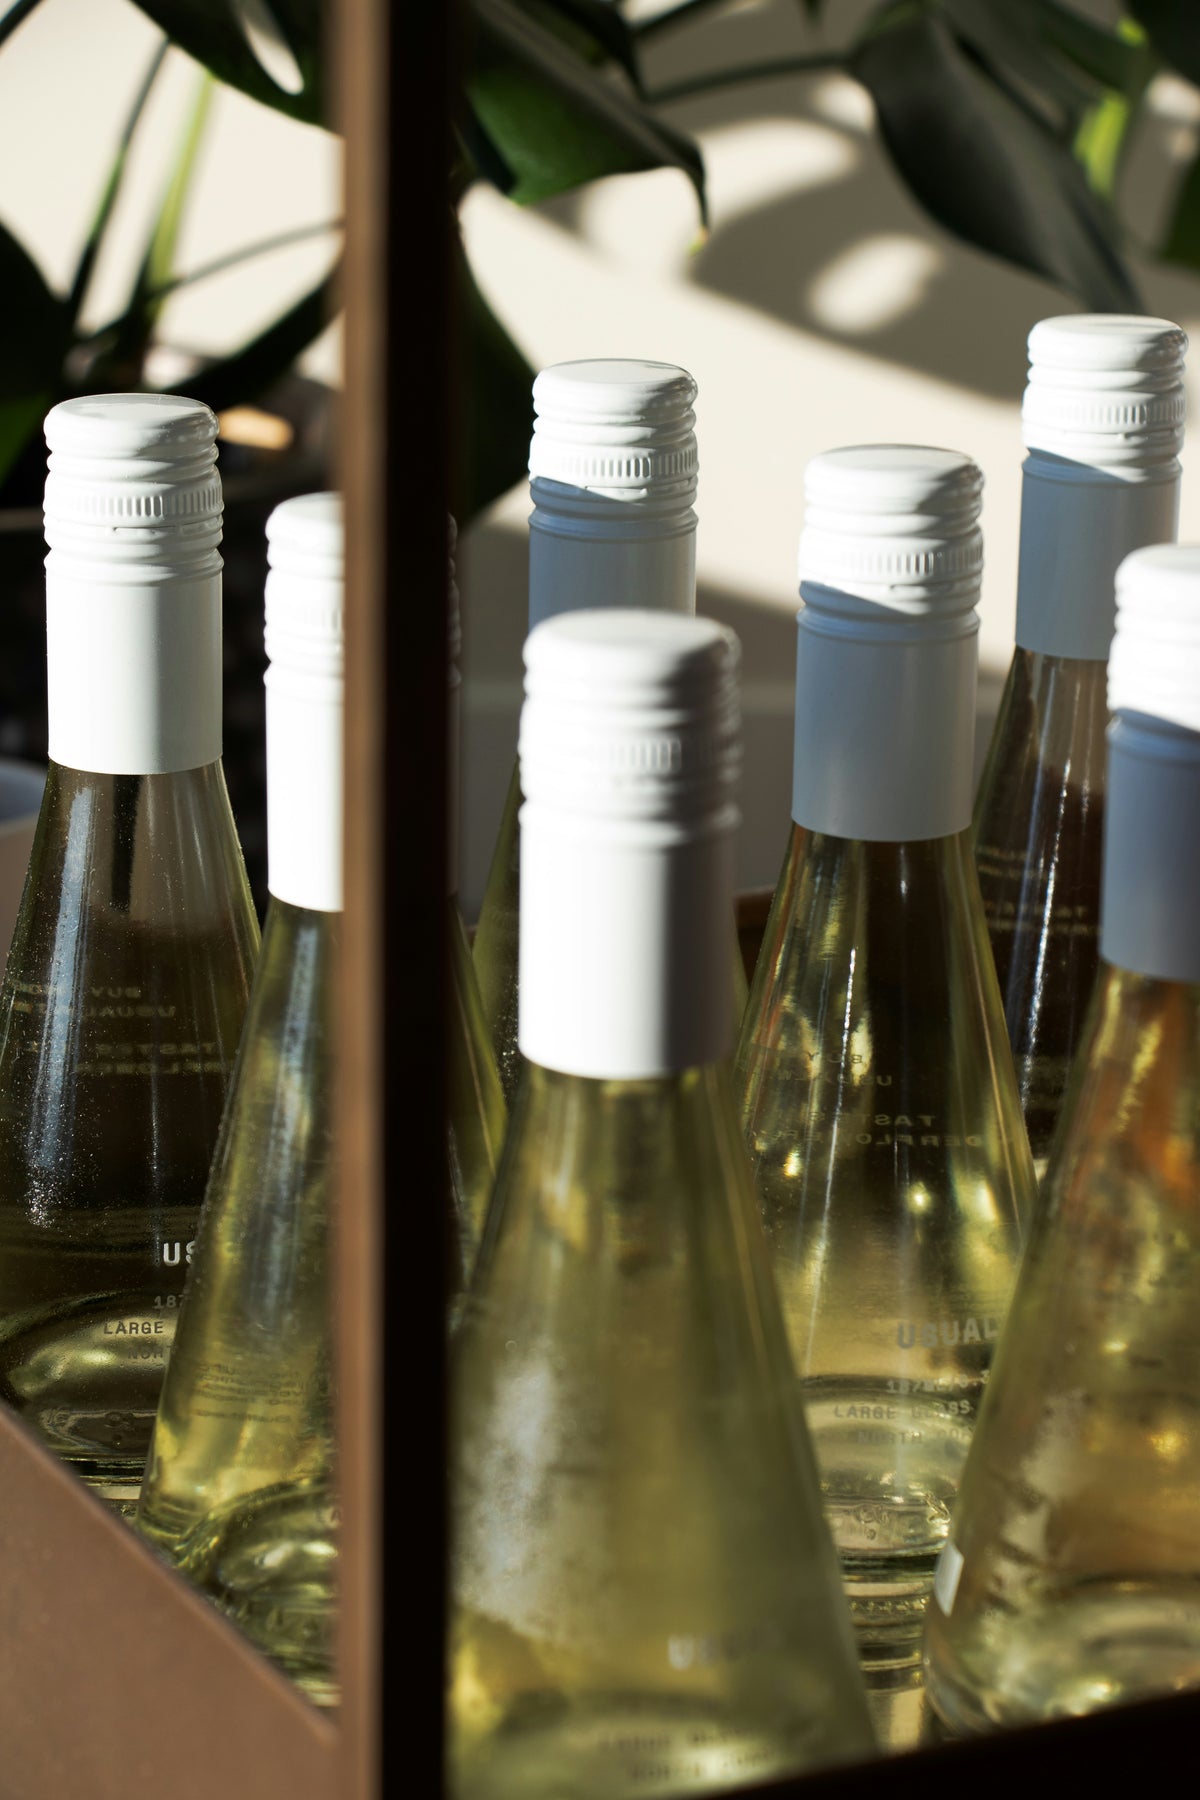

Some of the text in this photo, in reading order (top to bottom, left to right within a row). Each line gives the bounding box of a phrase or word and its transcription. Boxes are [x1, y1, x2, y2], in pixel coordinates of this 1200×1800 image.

[103, 1320, 164, 1335] LARGE
[896, 1318, 999, 1349] USUAL
[834, 1405, 896, 1420] LARGE
